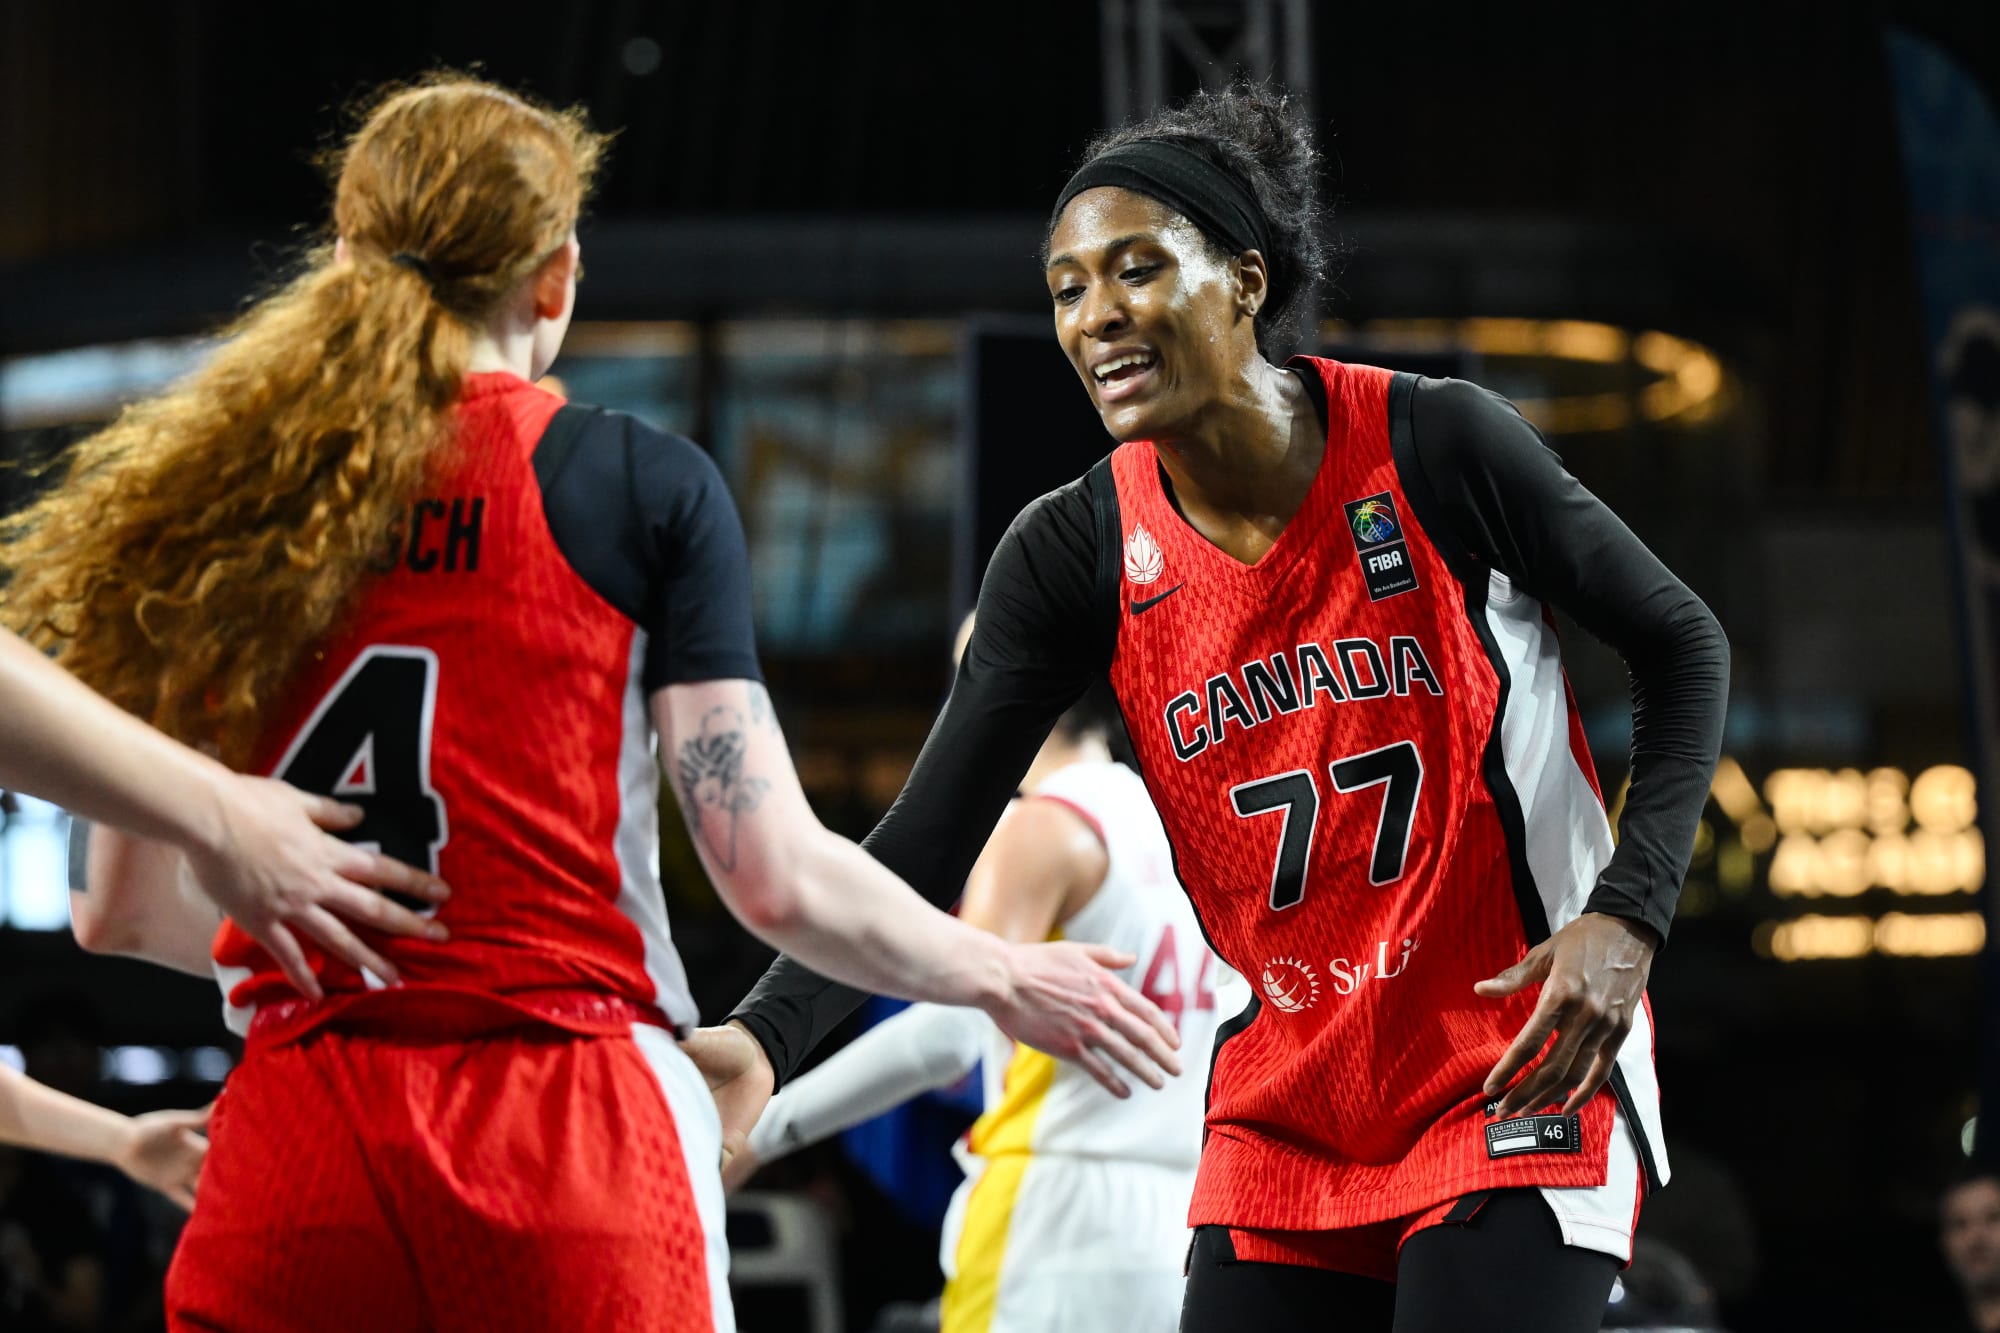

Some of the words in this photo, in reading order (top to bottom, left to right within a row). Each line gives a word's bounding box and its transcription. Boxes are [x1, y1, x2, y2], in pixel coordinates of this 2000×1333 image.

[1368, 550, 1403, 574] FIBA
[1164, 636, 1444, 762] CANADA
[269, 644, 449, 918] 4
[1229, 740, 1424, 912] 77
[1544, 1124, 1564, 1140] 46
